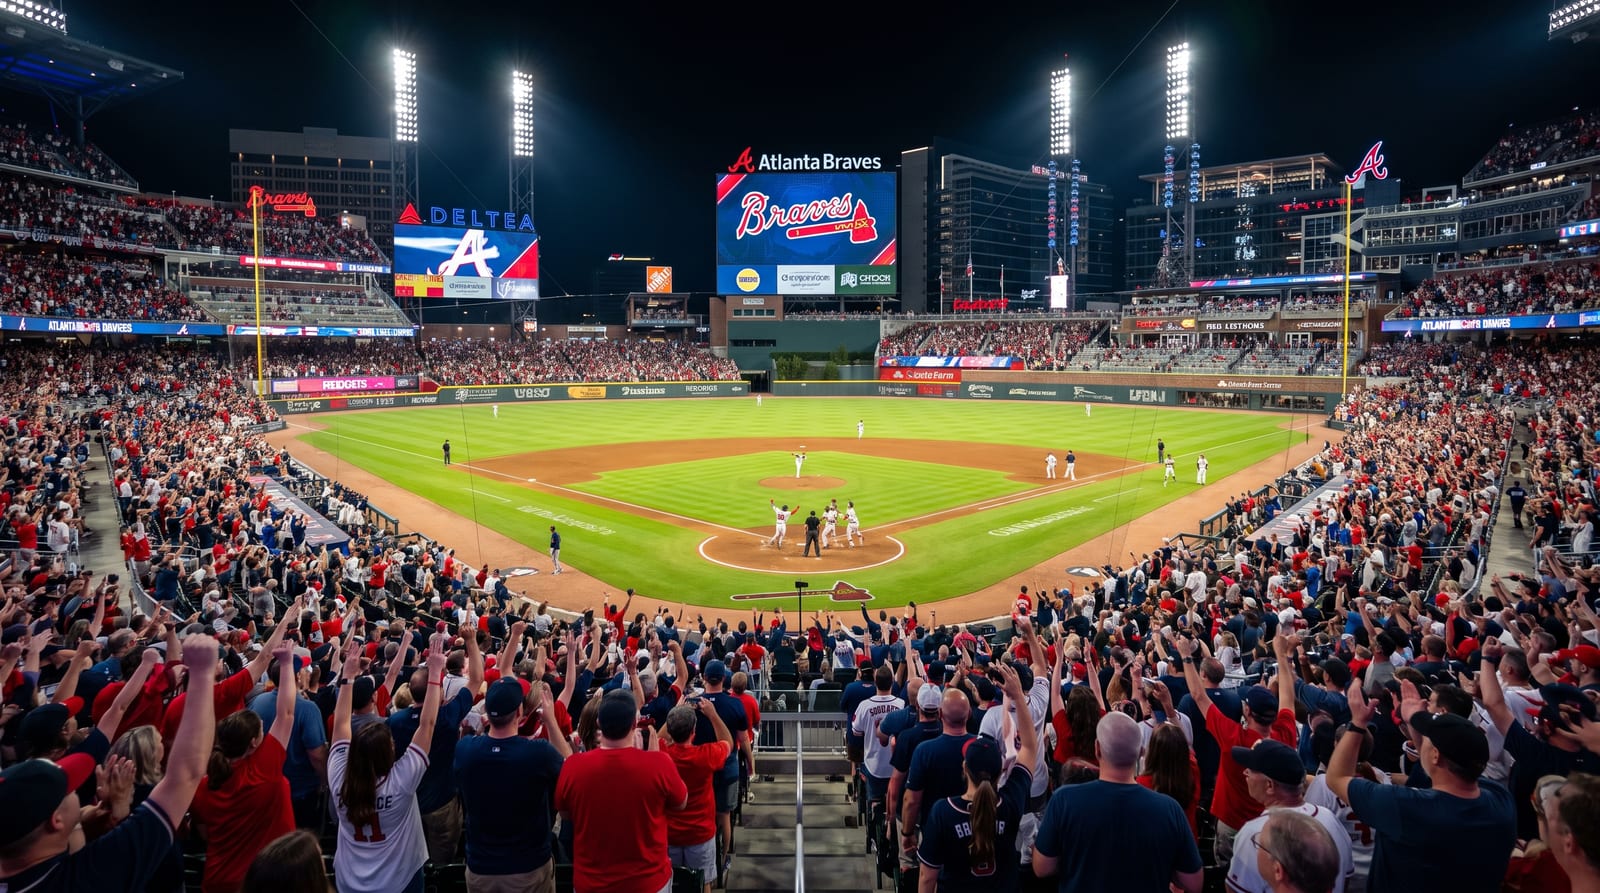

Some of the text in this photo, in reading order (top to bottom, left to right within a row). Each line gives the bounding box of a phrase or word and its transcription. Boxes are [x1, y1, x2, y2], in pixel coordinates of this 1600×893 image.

[758, 153, 882, 171] Atlanta Braves
[246, 185, 308, 209] Braves
[430, 206, 535, 231] DELTEA
[736, 191, 852, 240] Braves
